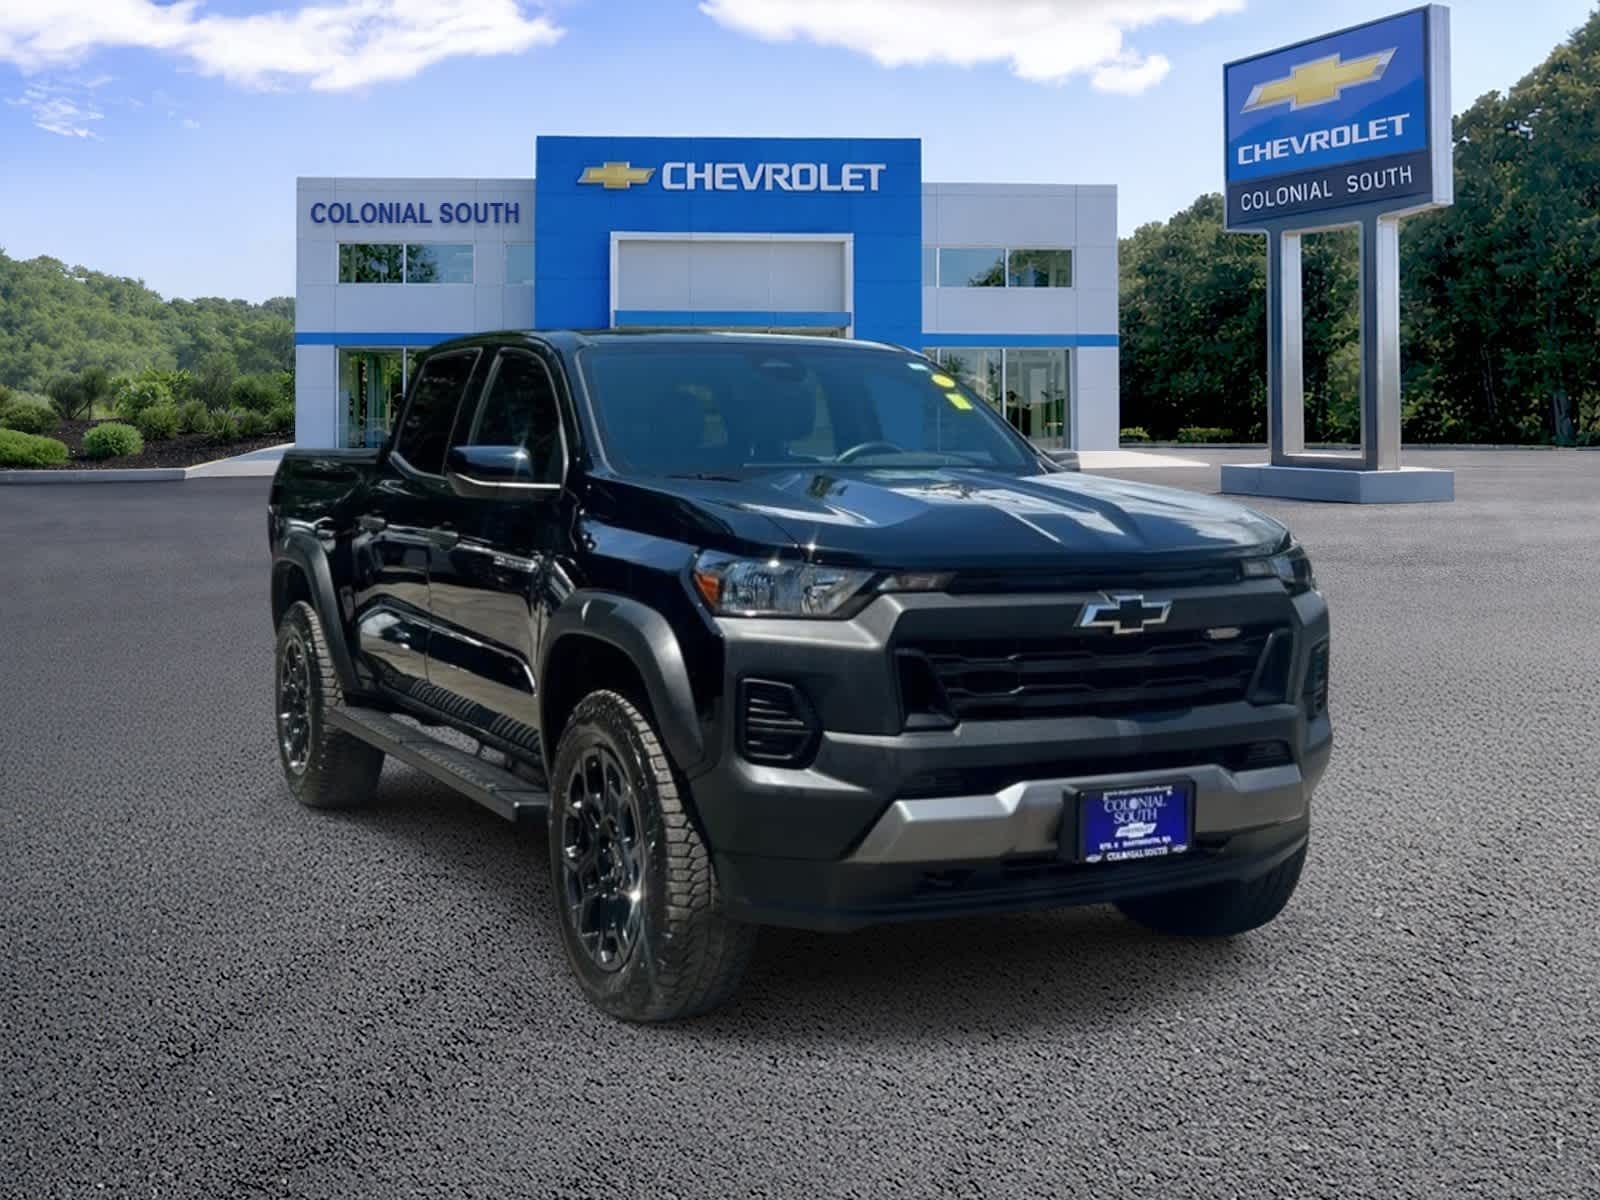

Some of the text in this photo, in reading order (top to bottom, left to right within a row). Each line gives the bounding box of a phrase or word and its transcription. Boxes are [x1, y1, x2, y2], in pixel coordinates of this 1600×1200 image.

[1237, 113, 1411, 165] CHEVROLET
[662, 162, 887, 192] CHEVROLET
[1241, 165, 1413, 211] COLONIAL SOUTH
[310, 201, 520, 224] COLONIAL SOUTH
[1104, 795, 1164, 813] COLONIAL
[1114, 808, 1157, 825] SOUTH
